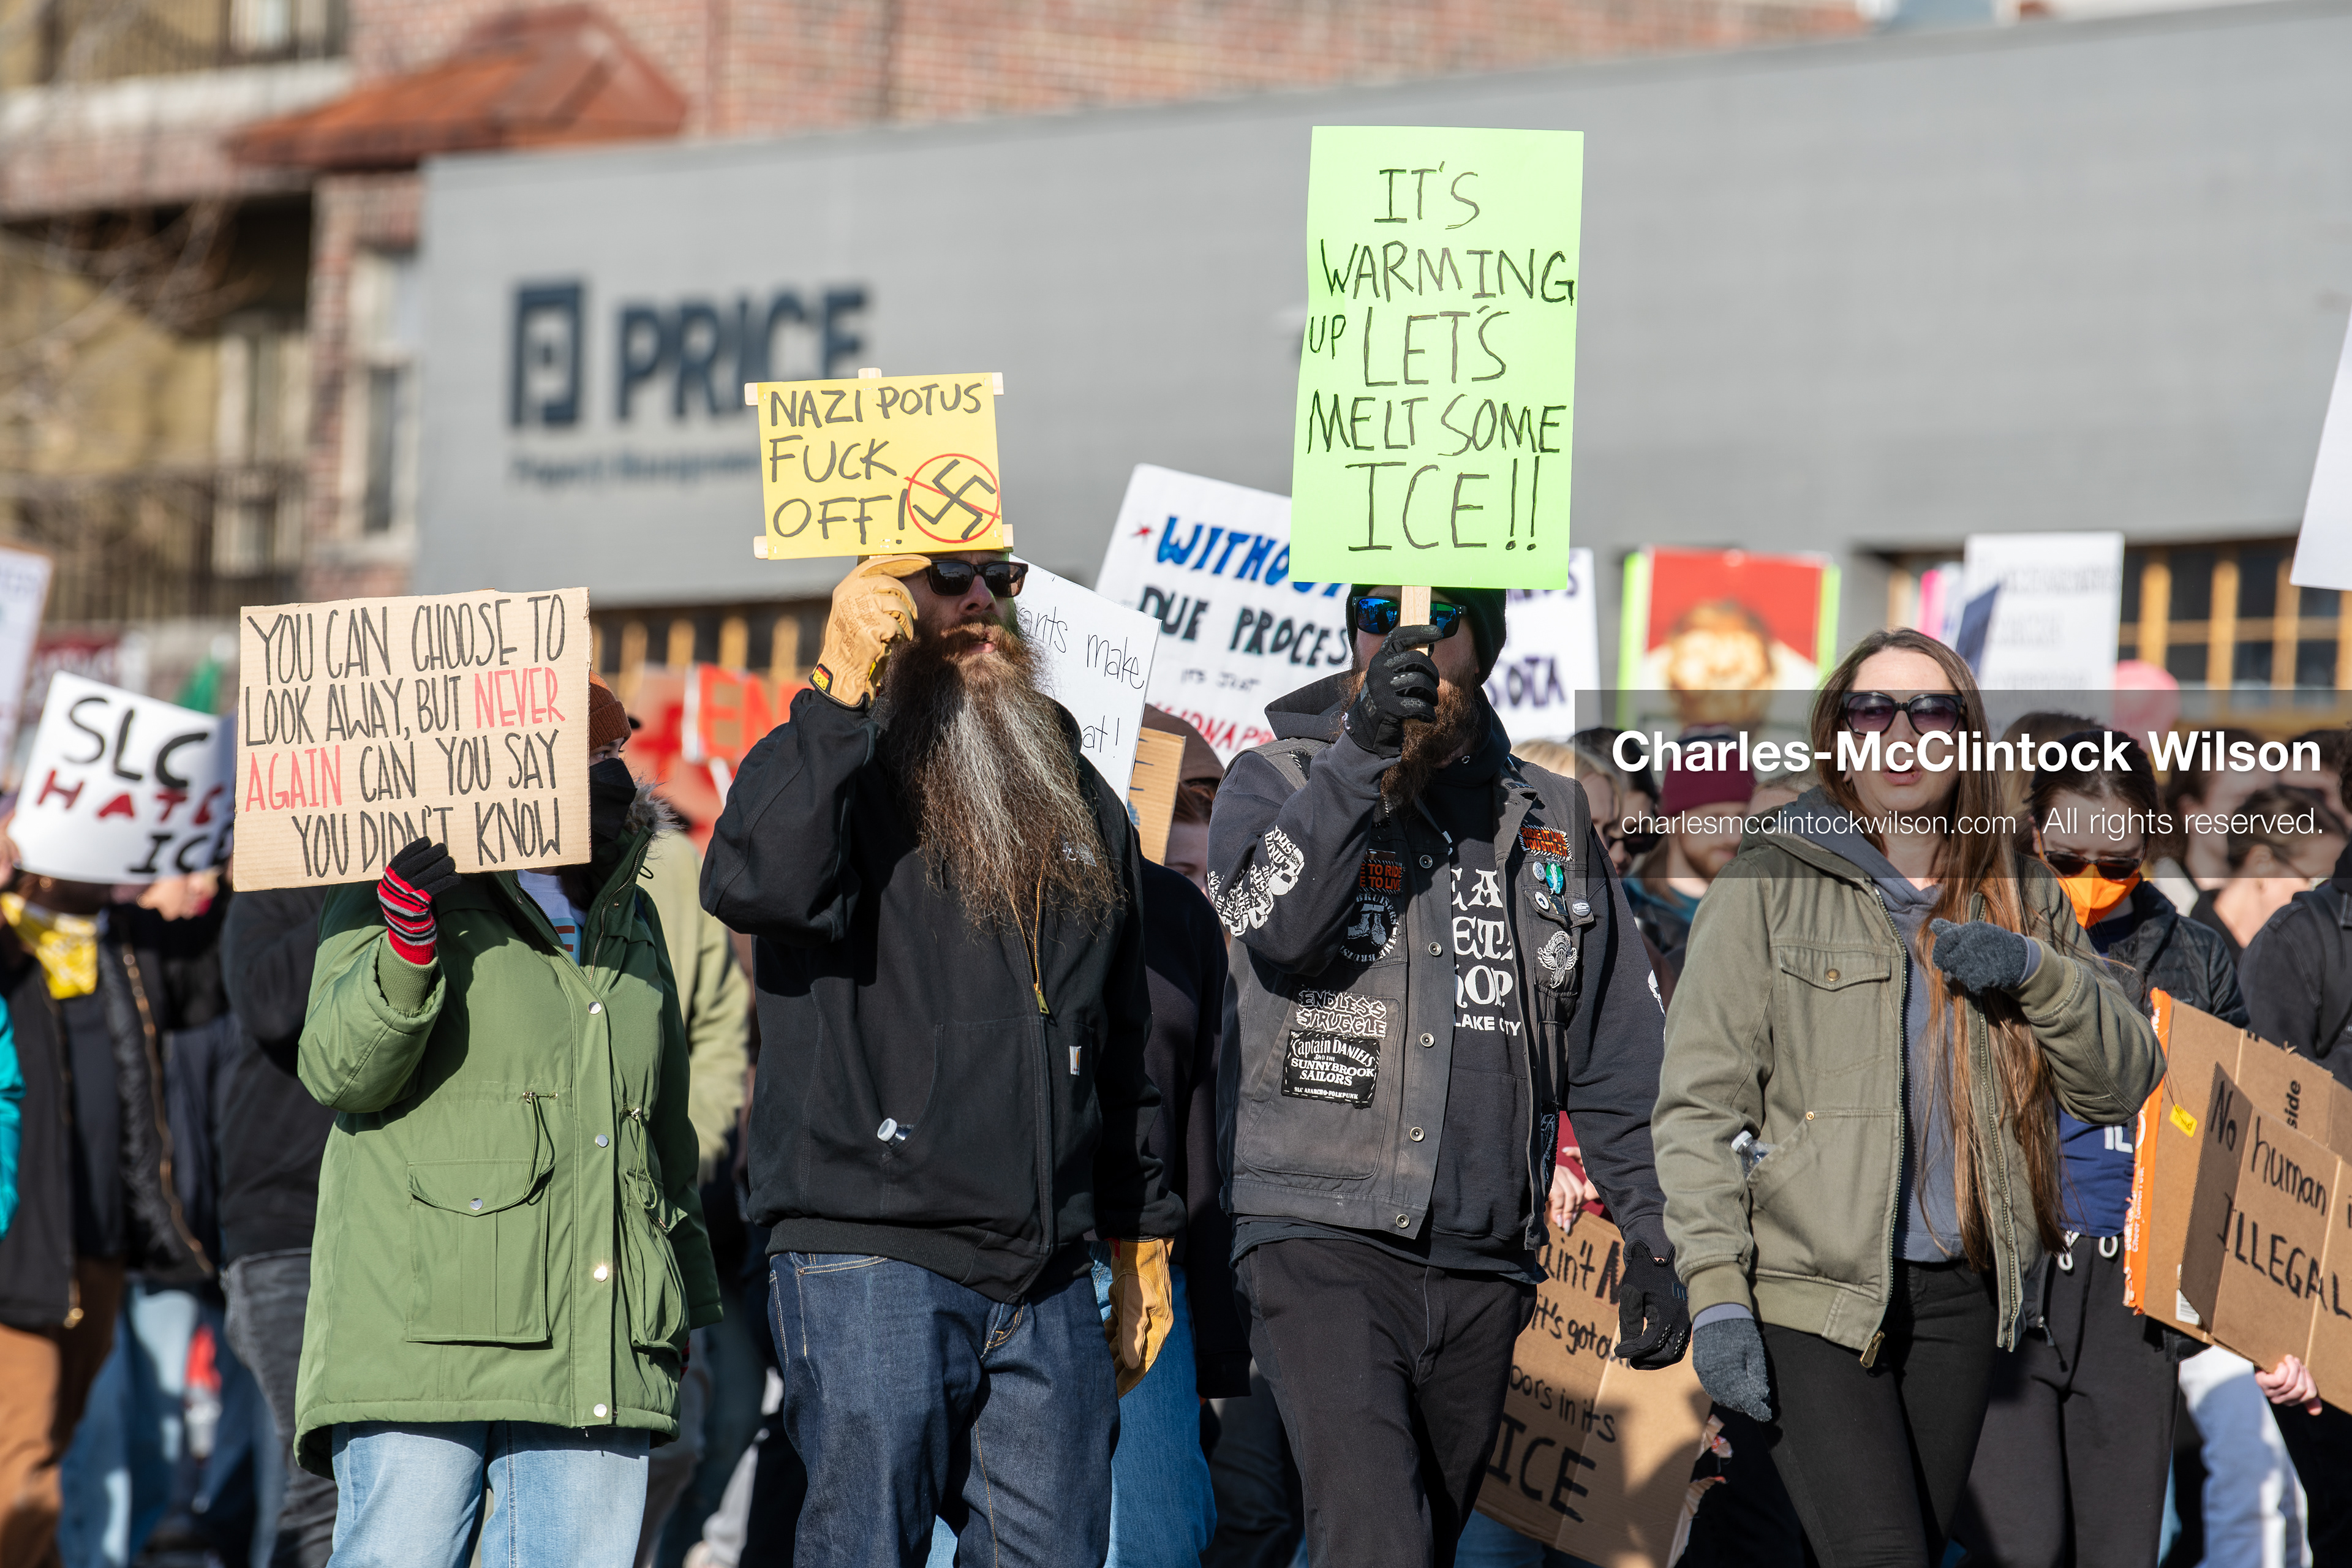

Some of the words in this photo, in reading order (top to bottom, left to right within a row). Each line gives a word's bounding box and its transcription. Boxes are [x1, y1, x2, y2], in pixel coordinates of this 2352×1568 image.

[1374, 161, 1480, 230] IT'S
[1321, 239, 1575, 306] WARMING
[617, 288, 869, 420] PRICE
[1309, 314, 1346, 360] UP
[1363, 305, 1511, 386] LET'S
[771, 390, 863, 428] NAZI
[876, 383, 982, 419] POTUS
[1307, 389, 1429, 454] MELT
[1438, 394, 1567, 456] SOME
[769, 435, 897, 483] FUCK
[1345, 455, 1540, 552] ICE!!
[1156, 515, 1348, 597] WITHO
[247, 614, 313, 685] YOU
[326, 606, 390, 679] CAN
[412, 599, 518, 671] CHOOSE
[527, 594, 565, 662] TO
[1139, 584, 1210, 641] DUE
[245, 686, 315, 746] LOOK
[325, 678, 410, 741] AWAY,
[415, 676, 461, 734] BUT
[475, 667, 565, 729] NEVER
[63, 696, 208, 788] SLC
[245, 745, 342, 812] AGAIN
[360, 741, 417, 802] CAN
[435, 735, 491, 796] YOU
[505, 729, 559, 790] SAY
[291, 813, 349, 878] YOU
[361, 805, 453, 873] DIDN'T
[475, 797, 561, 866] KNOW
[1520, 827, 1542, 840] RIDE
[1541, 830, 1550, 842] IT
[1523, 839, 1541, 851] YOU
[1540, 840, 1562, 856] STOLE
[1561, 846, 1568, 857] IT
[1368, 864, 1383, 875] TO
[1385, 865, 1401, 878] RIDE
[1368, 876, 1384, 888] TO
[1296, 1009, 1387, 1038] STRUGGLE
[1299, 990, 1387, 1019] ENDLESS
[1291, 1058, 1375, 1077] SUNNYBROOK
[1292, 1038, 1330, 1058] Captain
[1332, 1039, 1376, 1068] DANIELS
[1300, 1070, 1353, 1087] SAILORS
[2211, 1080, 2238, 1152] No
[2252, 1116, 2327, 1216] human
[2217, 1192, 2352, 1321] ILLEGAL
[1559, 1388, 1575, 1426] in
[1487, 1412, 1597, 1523] ICE
